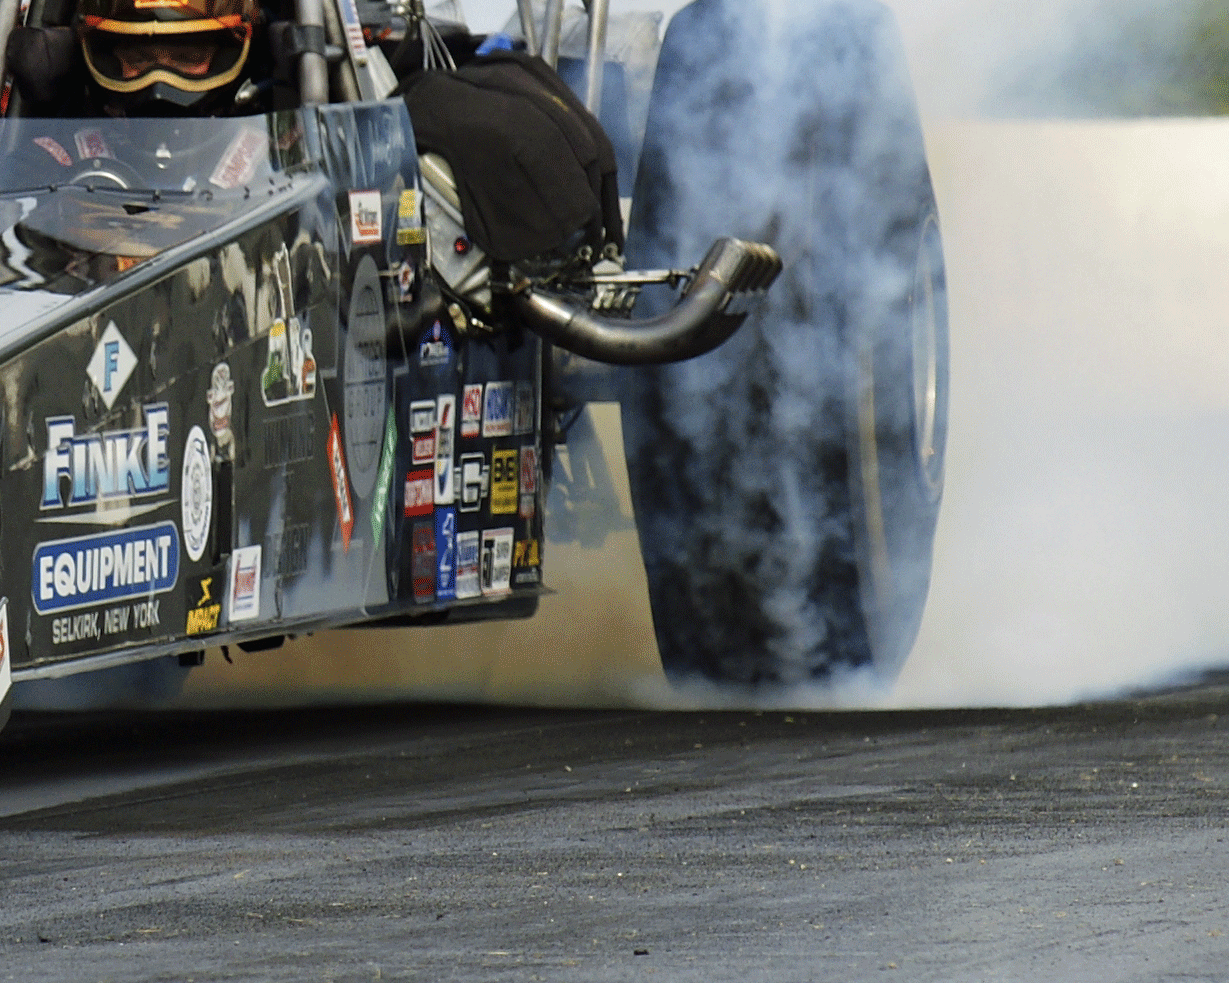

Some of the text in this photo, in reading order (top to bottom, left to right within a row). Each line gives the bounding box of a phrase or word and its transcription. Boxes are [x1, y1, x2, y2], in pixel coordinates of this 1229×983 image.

[103, 340, 119, 392] F
[40, 402, 170, 511] FINKE
[39, 535, 171, 601] EQUIPMENT
[52, 598, 160, 645] SELKIRK, NEW YORK
